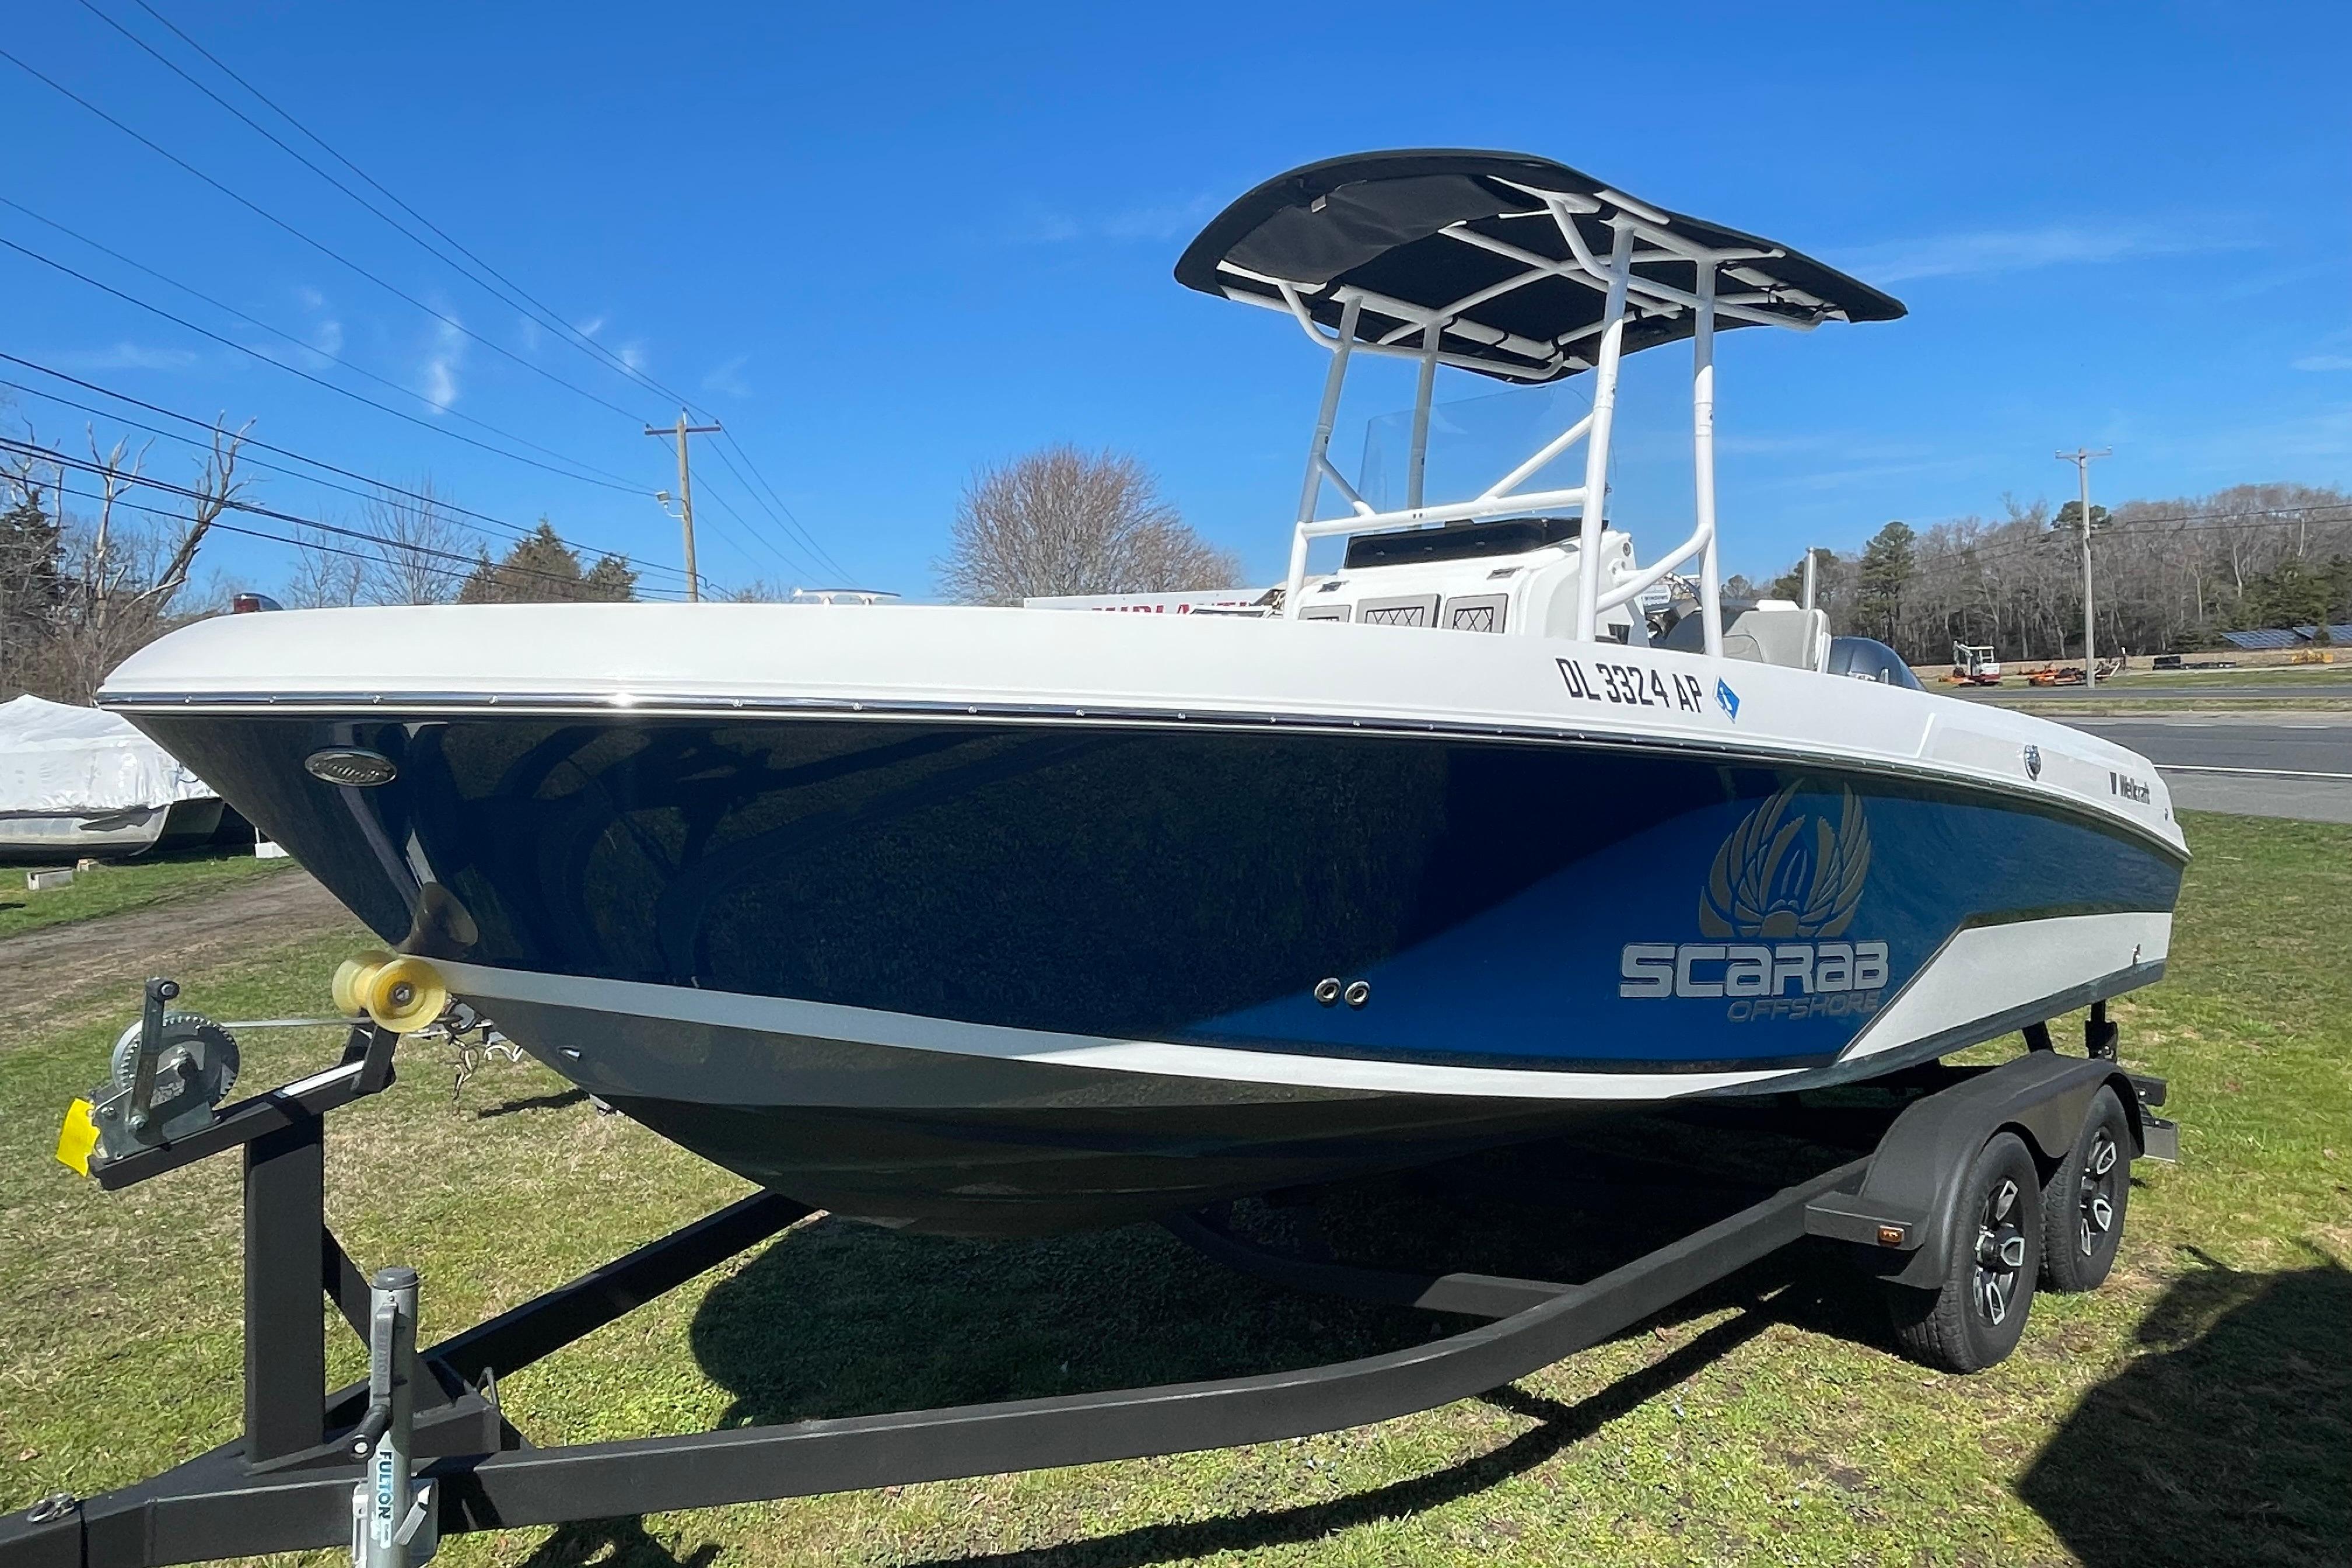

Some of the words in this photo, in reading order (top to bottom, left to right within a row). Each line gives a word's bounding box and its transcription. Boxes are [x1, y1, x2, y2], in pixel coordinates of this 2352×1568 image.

[1555, 658, 1601, 701] DL
[1595, 663, 1670, 708] 3324
[1672, 673, 1702, 713] AP
[1727, 992, 1880, 1023] OFFSHORE
[378, 1451, 392, 1520] FULTON
